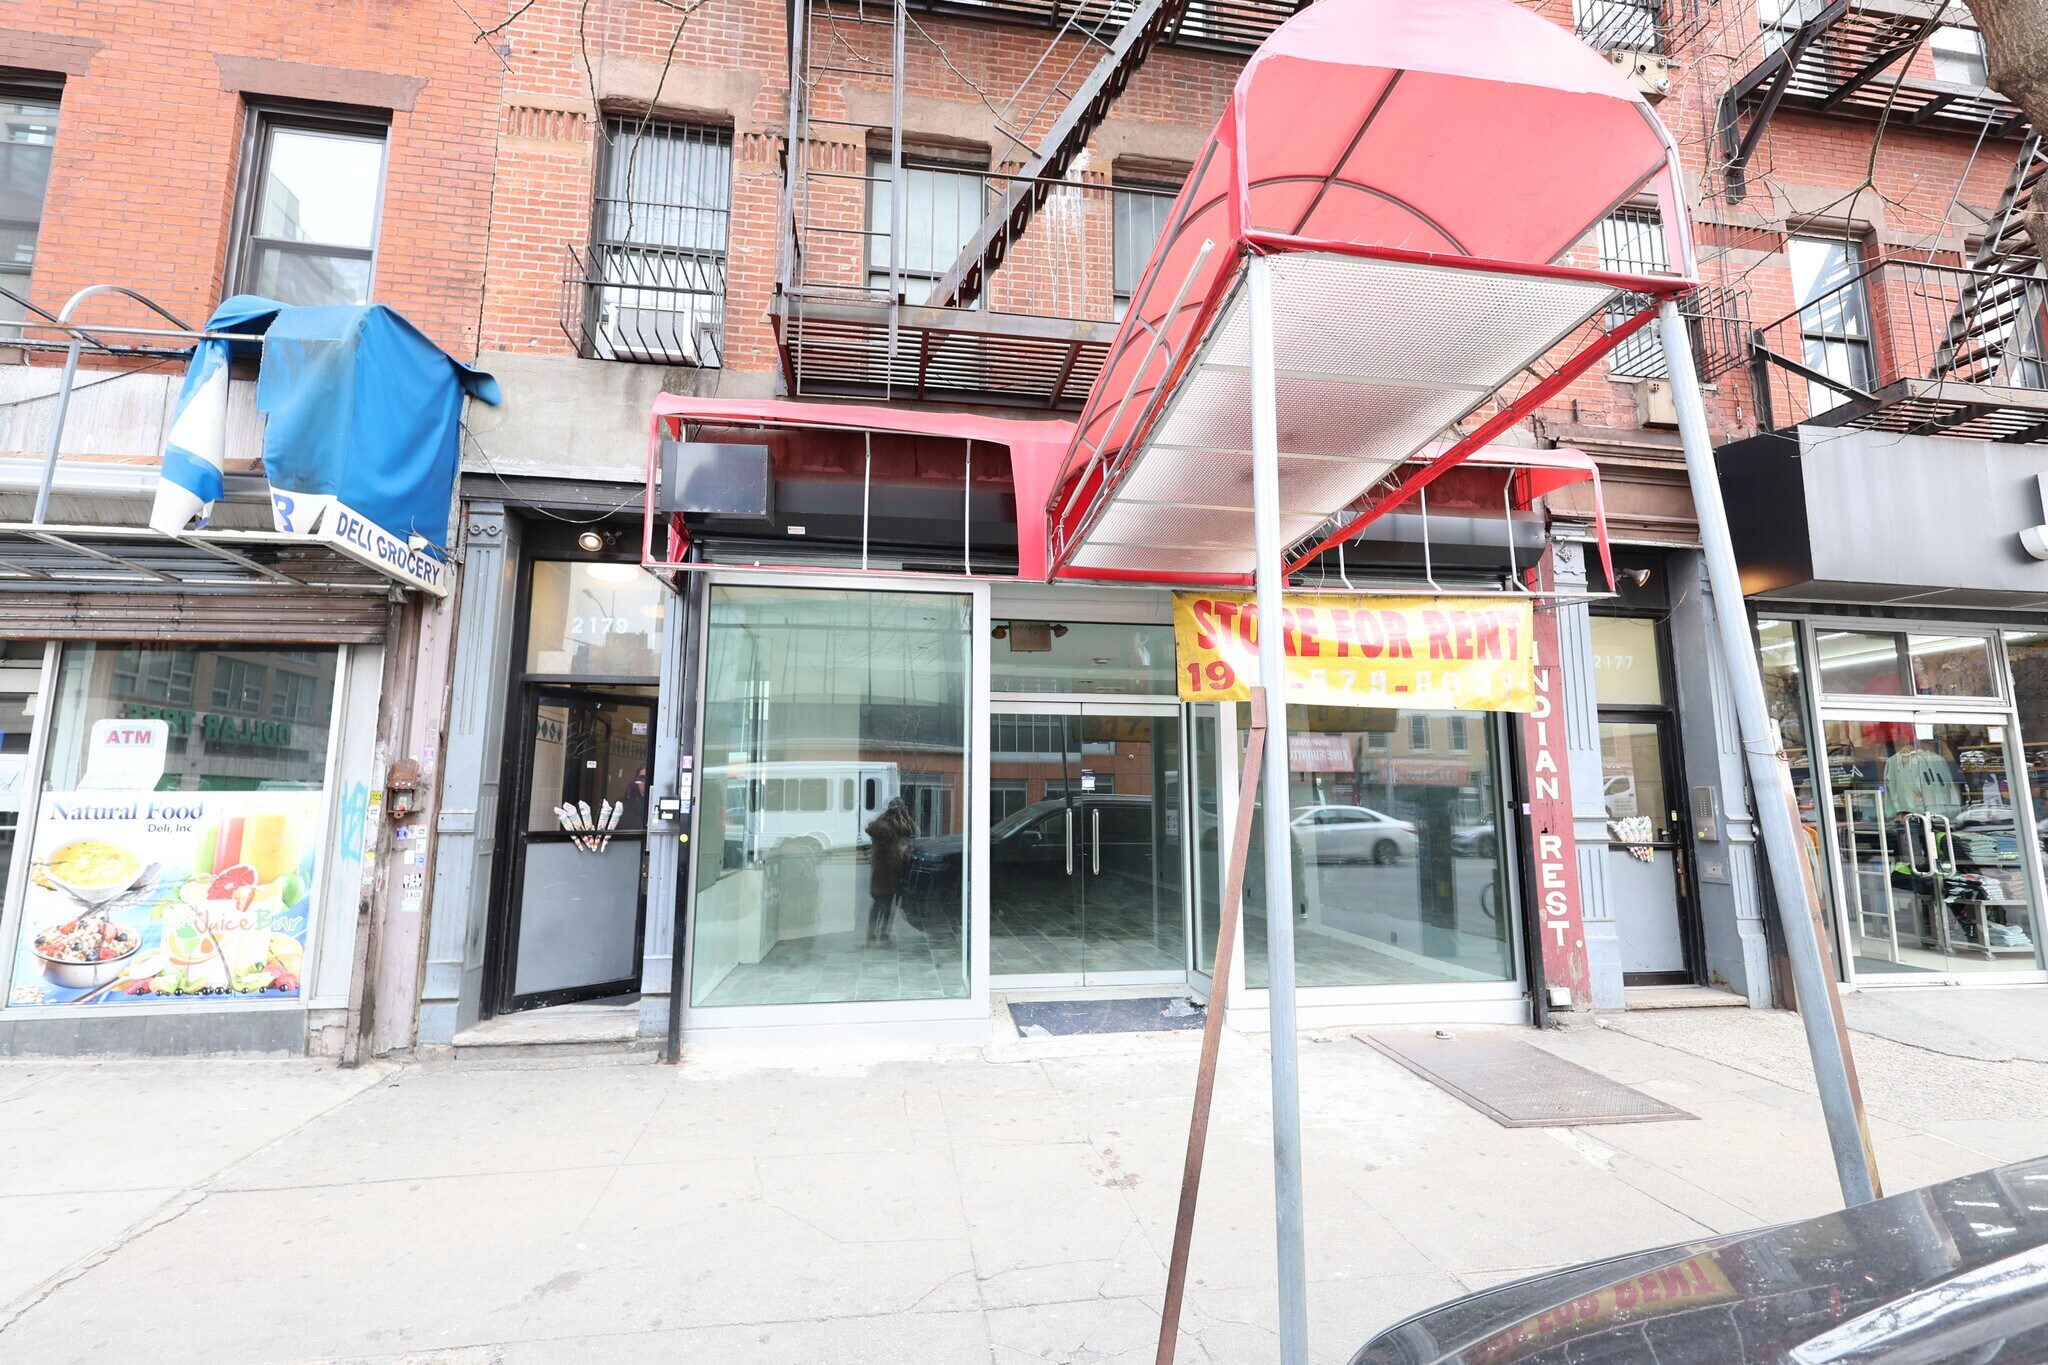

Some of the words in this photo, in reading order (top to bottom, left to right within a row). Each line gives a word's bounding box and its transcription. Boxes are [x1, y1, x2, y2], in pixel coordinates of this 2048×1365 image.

[336, 511, 372, 551] DELI
[376, 535, 440, 586] GROCERY
[572, 616, 628, 635] 2179
[1192, 600, 1321, 657] STORE
[1332, 609, 1413, 658] FOR
[1422, 610, 1520, 661] RENT
[1592, 654, 1634, 670] 2177
[106, 730, 152, 745] ATM
[50, 801, 138, 820] Natural
[146, 801, 204, 820] Food
[148, 824, 173, 834] Deli,
[175, 824, 193, 833] Inc
[1540, 835, 1583, 948] REST.
[193, 910, 254, 934] Juice
[255, 908, 303, 932] Bar
